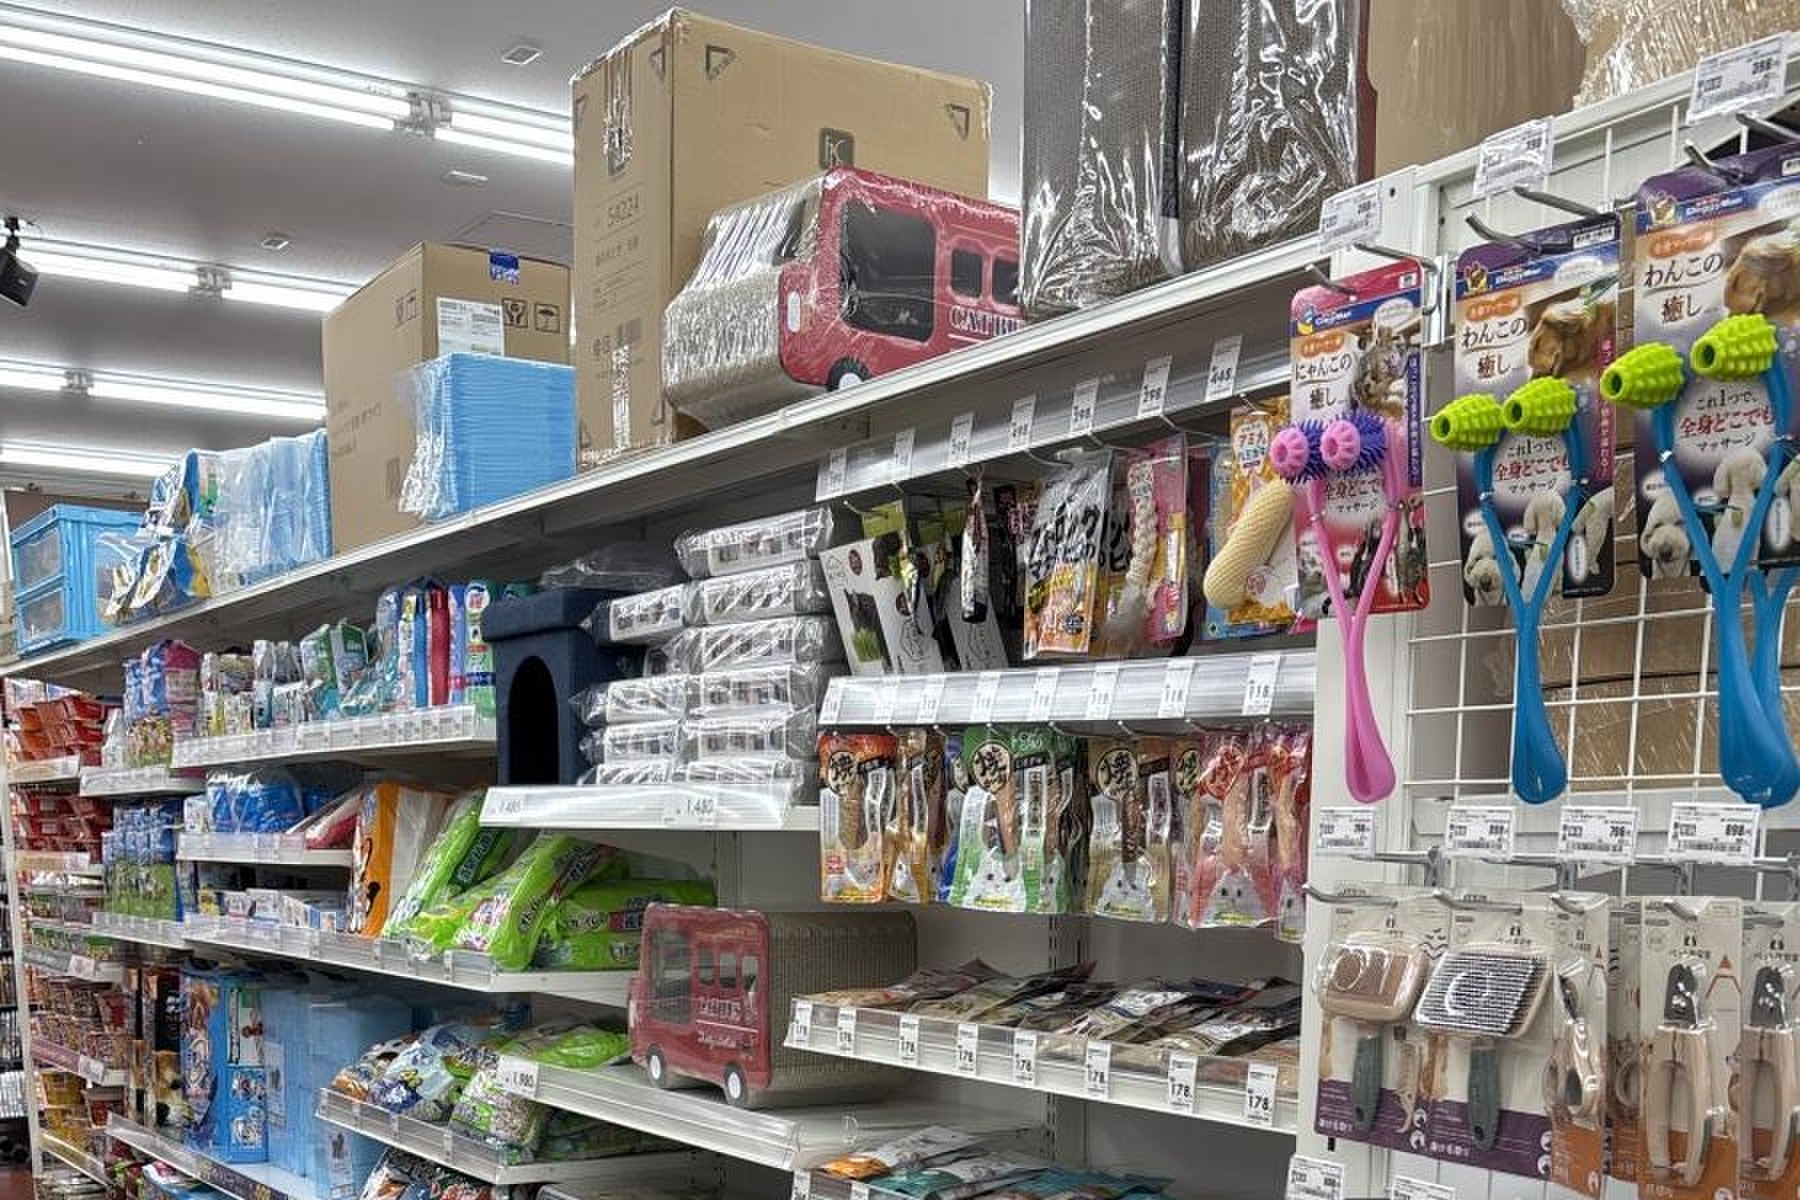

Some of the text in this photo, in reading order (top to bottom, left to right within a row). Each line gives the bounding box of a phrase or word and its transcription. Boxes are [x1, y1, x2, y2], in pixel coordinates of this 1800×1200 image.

[1643, 252, 1724, 288] わんこの
[1661, 294, 1701, 324] 癒し
[1463, 317, 1528, 349] わんこの
[1295, 353, 1353, 382] にゃんこの
[1477, 354, 1511, 381] 癒し
[1309, 386, 1337, 411] 癒し
[1680, 409, 1776, 440] 全身どこでも
[1697, 432, 1756, 452] マッサージ
[1171, 1082, 1191, 1098] 178
[1249, 1094, 1270, 1112] 178
